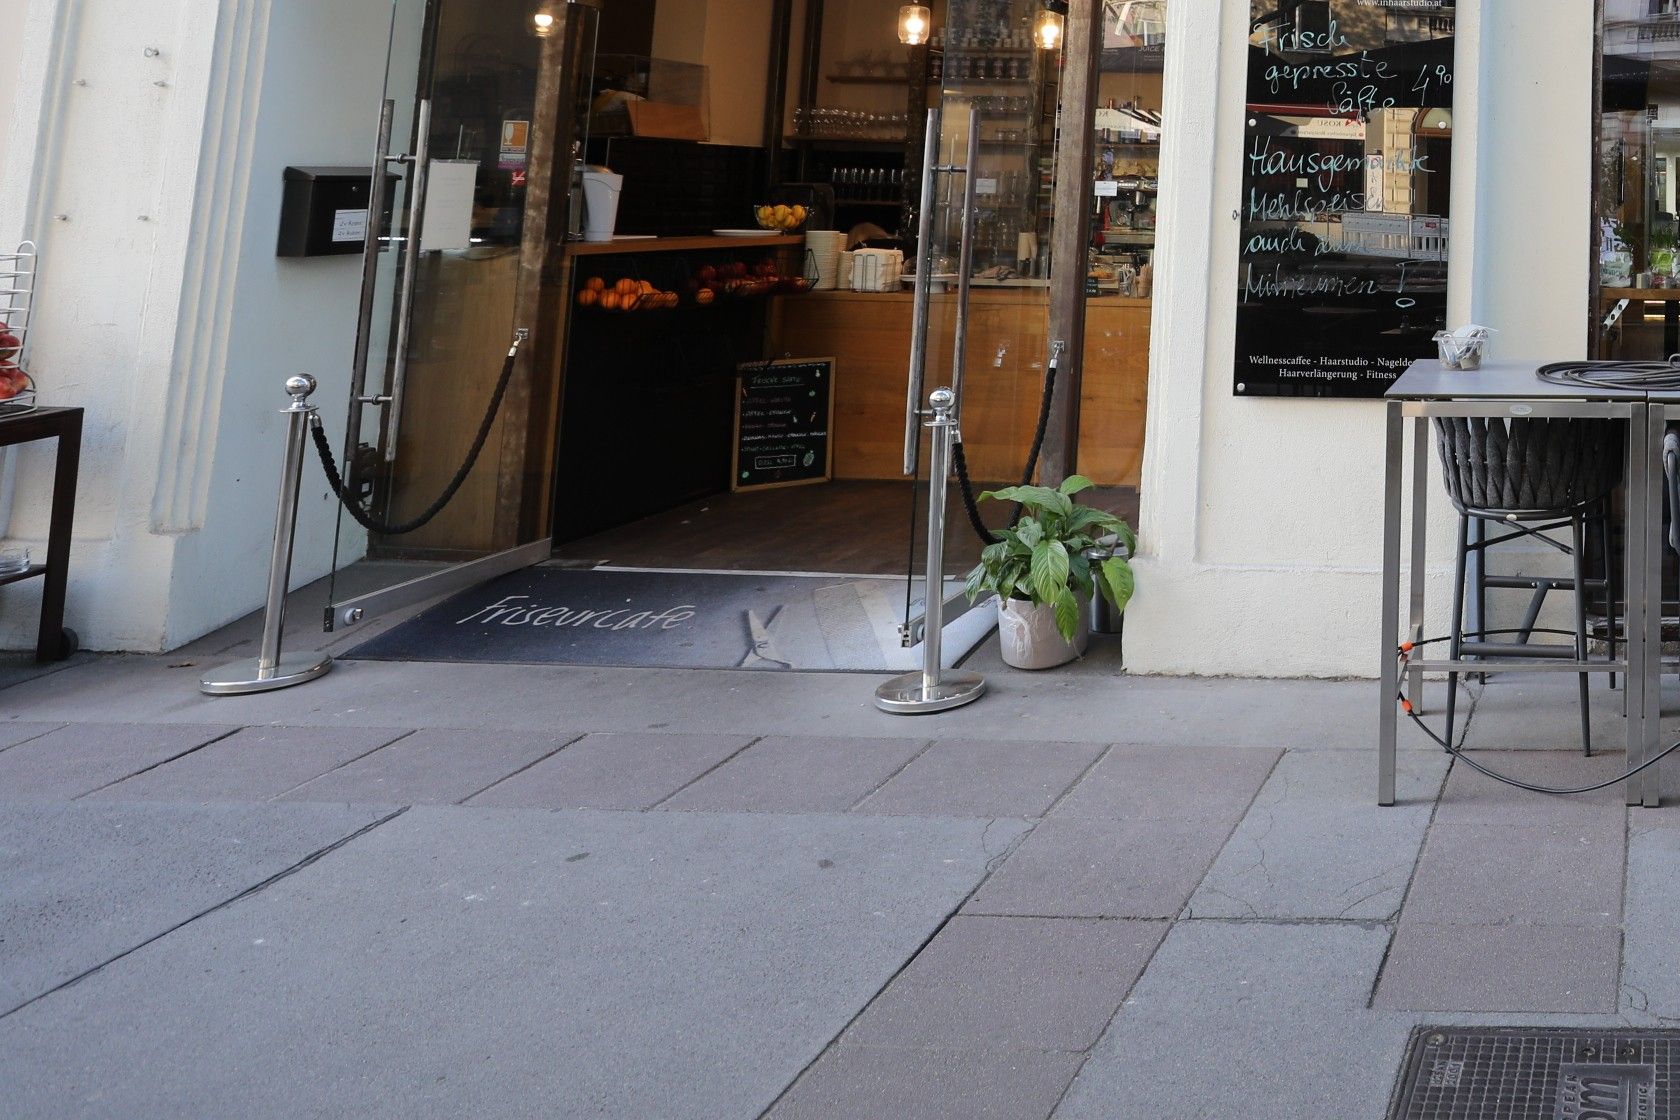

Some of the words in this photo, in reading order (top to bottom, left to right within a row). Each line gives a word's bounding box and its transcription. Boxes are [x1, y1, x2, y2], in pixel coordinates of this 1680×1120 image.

[1249, 355, 1312, 366] Wellnesscaffee
[1319, 356, 1369, 366] Haarstudio
[1376, 357, 1415, 369] Nagelde
[1278, 368, 1359, 381] Haarverlängerung
[1366, 369, 1397, 380] Fitness
